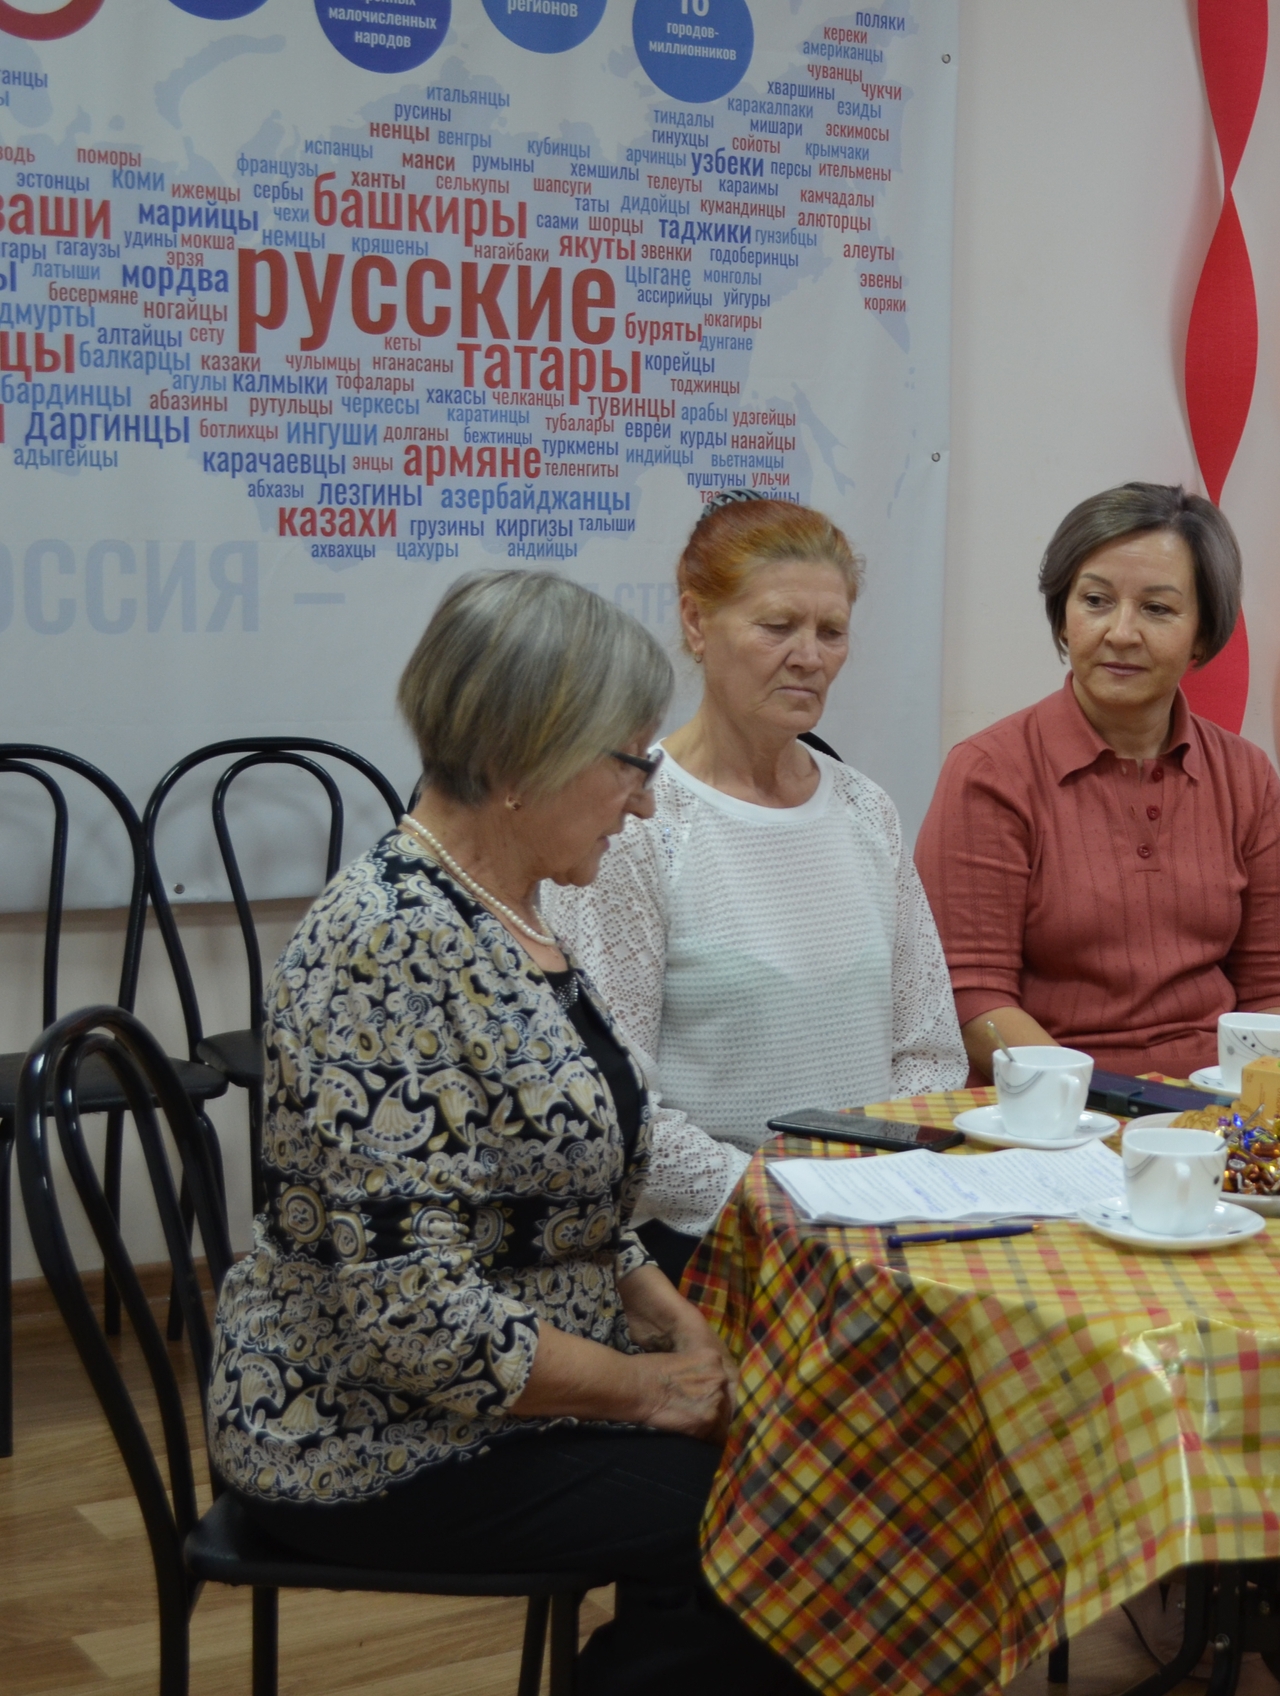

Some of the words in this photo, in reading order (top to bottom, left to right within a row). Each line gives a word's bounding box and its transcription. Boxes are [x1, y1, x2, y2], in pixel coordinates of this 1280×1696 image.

[328, 7, 437, 30] малочисленных
[856, 11, 905, 31] поляки
[354, 31, 412, 49] народов
[667, 22, 719, 39] городов-
[824, 26, 868, 45] кереки
[649, 41, 737, 61] миллионников
[803, 41, 883, 64] американцы
[0, 69, 48, 90] анцы
[807, 63, 863, 84] чуванцы
[426, 86, 510, 108] итальянцы
[767, 80, 835, 101] хваршины
[861, 82, 902, 101] чукчи
[394, 103, 452, 122] русины
[727, 97, 814, 119] каракалпаки
[837, 101, 882, 121] езиды
[654, 109, 714, 129] тиндалы
[750, 118, 803, 139] мишари
[370, 121, 430, 144] ненцы
[438, 130, 492, 150] венгры
[652, 129, 709, 149] гинухцы
[825, 122, 889, 142] эскимосы
[305, 139, 374, 161] испанцы
[527, 136, 591, 159] кубинцы
[732, 134, 781, 154] сойоты
[805, 142, 870, 161] крымчаки
[77, 148, 141, 169] поморы
[237, 153, 318, 178] французы
[402, 152, 456, 172] манси
[473, 154, 535, 173] румыны
[626, 147, 687, 167] арчинцы
[691, 147, 764, 177] узбеки
[570, 162, 640, 182] хемшилы
[770, 160, 812, 179] персы
[818, 162, 892, 182] ительмены
[17, 172, 90, 193] эстонцы
[351, 171, 406, 190] ханты
[436, 175, 510, 196] селькупы
[533, 176, 592, 197] шапсуги
[647, 174, 702, 194] телеуты
[719, 178, 779, 197] караимы
[171, 183, 241, 204] ижемцы
[254, 181, 303, 203] сербы
[800, 188, 875, 208] камчадалы
[273, 206, 309, 223] чехи
[314, 171, 527, 248] башкиры
[574, 197, 610, 213] таты
[620, 193, 690, 217] дидойцы
[700, 198, 786, 220] кумандинцы
[0, 193, 111, 240] аши
[138, 201, 259, 235] марийцы
[536, 213, 579, 231] саами
[588, 215, 644, 236] шорцы
[798, 211, 871, 233] алюторцы
[124, 231, 177, 249] удины
[181, 233, 235, 250] мокша
[262, 228, 326, 251] немцы
[658, 217, 752, 246] таджики
[755, 227, 818, 248] гунзибцы
[56, 240, 120, 260] гагаузы
[352, 236, 429, 257] кряшены
[474, 242, 549, 262] нагайбаки
[559, 235, 636, 264] якуты
[641, 243, 692, 262] эвенки
[843, 243, 895, 263] алеуты
[166, 251, 204, 270] эрзя
[710, 246, 799, 269] годоберинцы
[32, 262, 100, 281] латыши
[122, 263, 229, 297] мордва
[625, 265, 692, 287] цыгане
[703, 268, 762, 286] монголы
[860, 272, 902, 290] эвены
[49, 281, 139, 307] бесермяне
[238, 248, 616, 354] русские
[637, 288, 712, 309] ассирийцы
[723, 289, 771, 310] уйгуры
[144, 297, 228, 324] ногайцы
[864, 297, 906, 315] коряки
[625, 311, 703, 346] буряты
[704, 312, 762, 332] юкагиры
[97, 323, 183, 350] алтайцы
[189, 327, 225, 345] сету
[384, 336, 421, 352] кеты
[699, 334, 753, 352] дунгане
[79, 341, 191, 375] балкарцы
[201, 354, 261, 372] казаки
[285, 354, 360, 374] чулымцы
[372, 356, 454, 373] нганасаны
[645, 351, 715, 375] корейцы
[172, 374, 227, 394] агулы
[233, 373, 328, 395] калмыки
[457, 342, 641, 406] татары
[1, 374, 132, 411] бардинцы
[336, 375, 415, 395] тофалары
[670, 377, 740, 397] тоджинцы
[150, 389, 228, 411] абазины
[426, 387, 486, 405] хакасы
[492, 391, 565, 409] челканцы
[249, 396, 333, 418] рутульцы
[341, 396, 420, 418] черкесы
[447, 407, 530, 426] каратинцы
[587, 396, 676, 420] тувинцы
[681, 401, 728, 425] арабы
[199, 418, 279, 440] ботлихцы
[545, 413, 615, 435] тубалары
[732, 408, 796, 429] удэгейцы
[25, 411, 190, 449] даргинцы
[287, 421, 378, 450] ингуши
[383, 425, 449, 443] долганы
[464, 427, 533, 447] бежтинцы
[625, 421, 671, 442] евреи
[680, 430, 727, 449] курды
[542, 439, 619, 458] туркмены
[731, 431, 796, 453] нанайцы
[14, 444, 118, 471] адыгейцы
[203, 451, 346, 479] карачаевцы
[352, 455, 393, 473] энцы
[404, 444, 541, 486] армяне
[626, 446, 693, 467] индийцы
[711, 453, 784, 471] вьетнамцы
[545, 462, 619, 478] теленгиты
[687, 472, 746, 489] пуштуны
[752, 471, 790, 488] ульчи
[248, 478, 304, 499] абхазы
[318, 482, 422, 507] лезгины
[441, 481, 631, 515] азербайджанцы
[278, 506, 397, 537] казахи
[410, 519, 484, 541] грузины
[496, 518, 573, 542] киргизы
[578, 517, 636, 532] талыши
[311, 543, 376, 561] ахвахцы
[397, 541, 459, 562] цахуры
[508, 538, 578, 560] андийцы
[0, 538, 259, 635] ССИЯ
